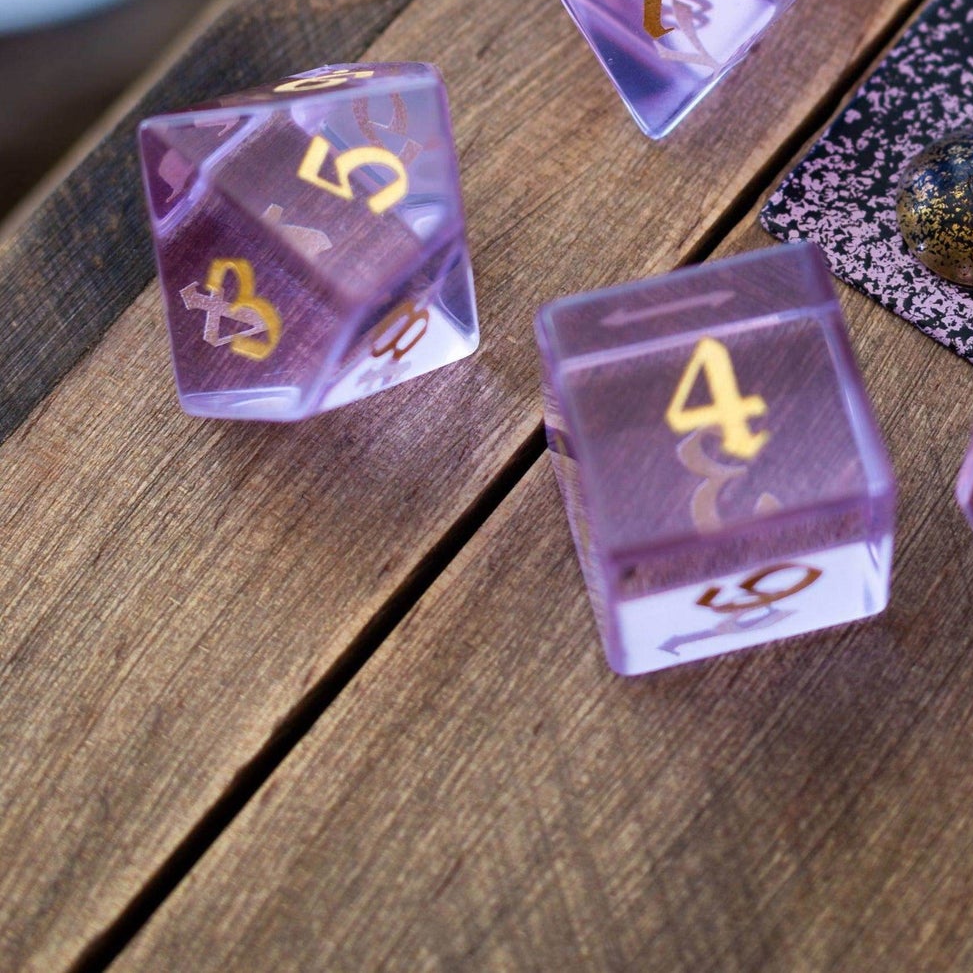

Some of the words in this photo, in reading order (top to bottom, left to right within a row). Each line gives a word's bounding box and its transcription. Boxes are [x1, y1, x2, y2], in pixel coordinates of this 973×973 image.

[297, 134, 410, 215] 5
[204, 257, 283, 361] 3
[370, 298, 430, 361] 8
[665, 336, 771, 461] 4
